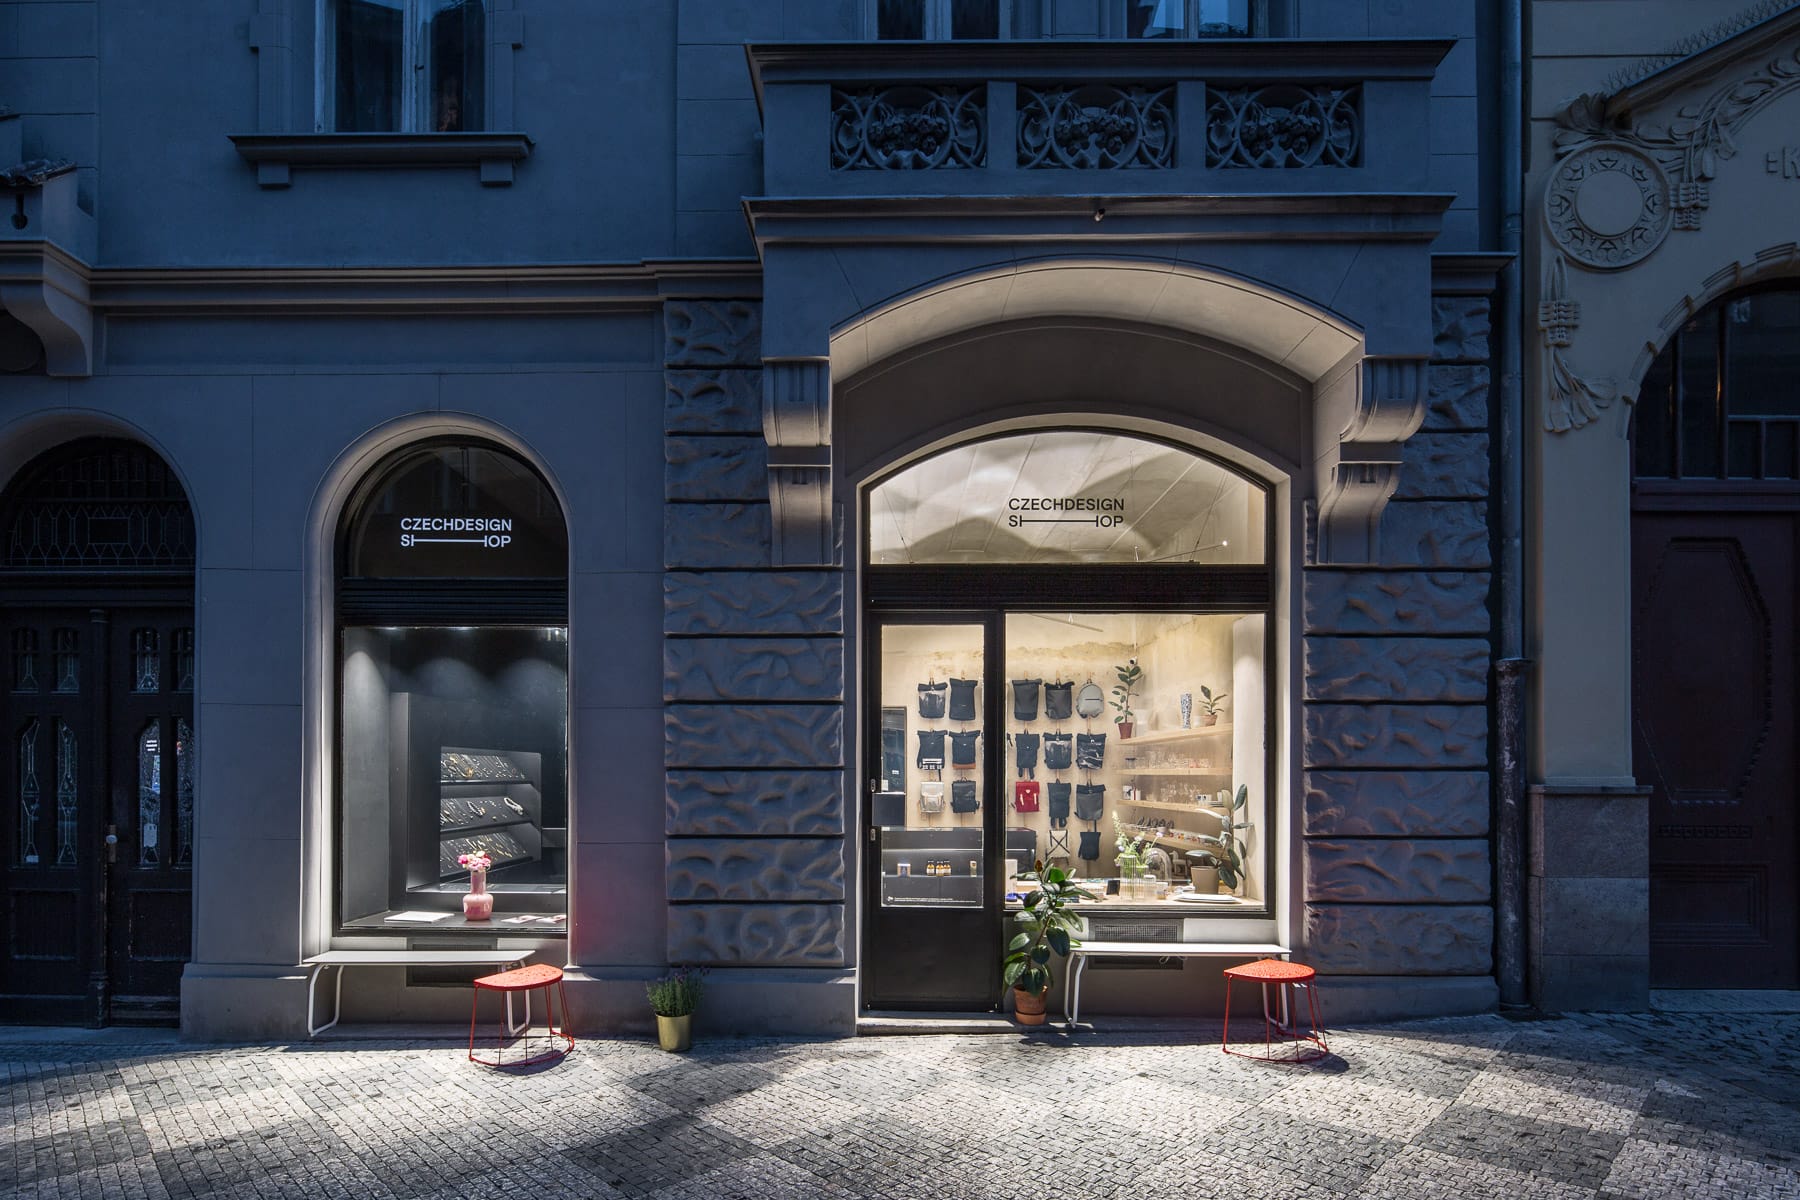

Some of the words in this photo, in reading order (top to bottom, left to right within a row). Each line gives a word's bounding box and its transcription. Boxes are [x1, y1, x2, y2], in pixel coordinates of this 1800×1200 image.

[1008, 498, 1125, 511] CZECHDESIGN
[400, 518, 512, 531] CZECHDESIGN
[1008, 515, 1124, 528] SHOP
[400, 534, 511, 548] SHOP
